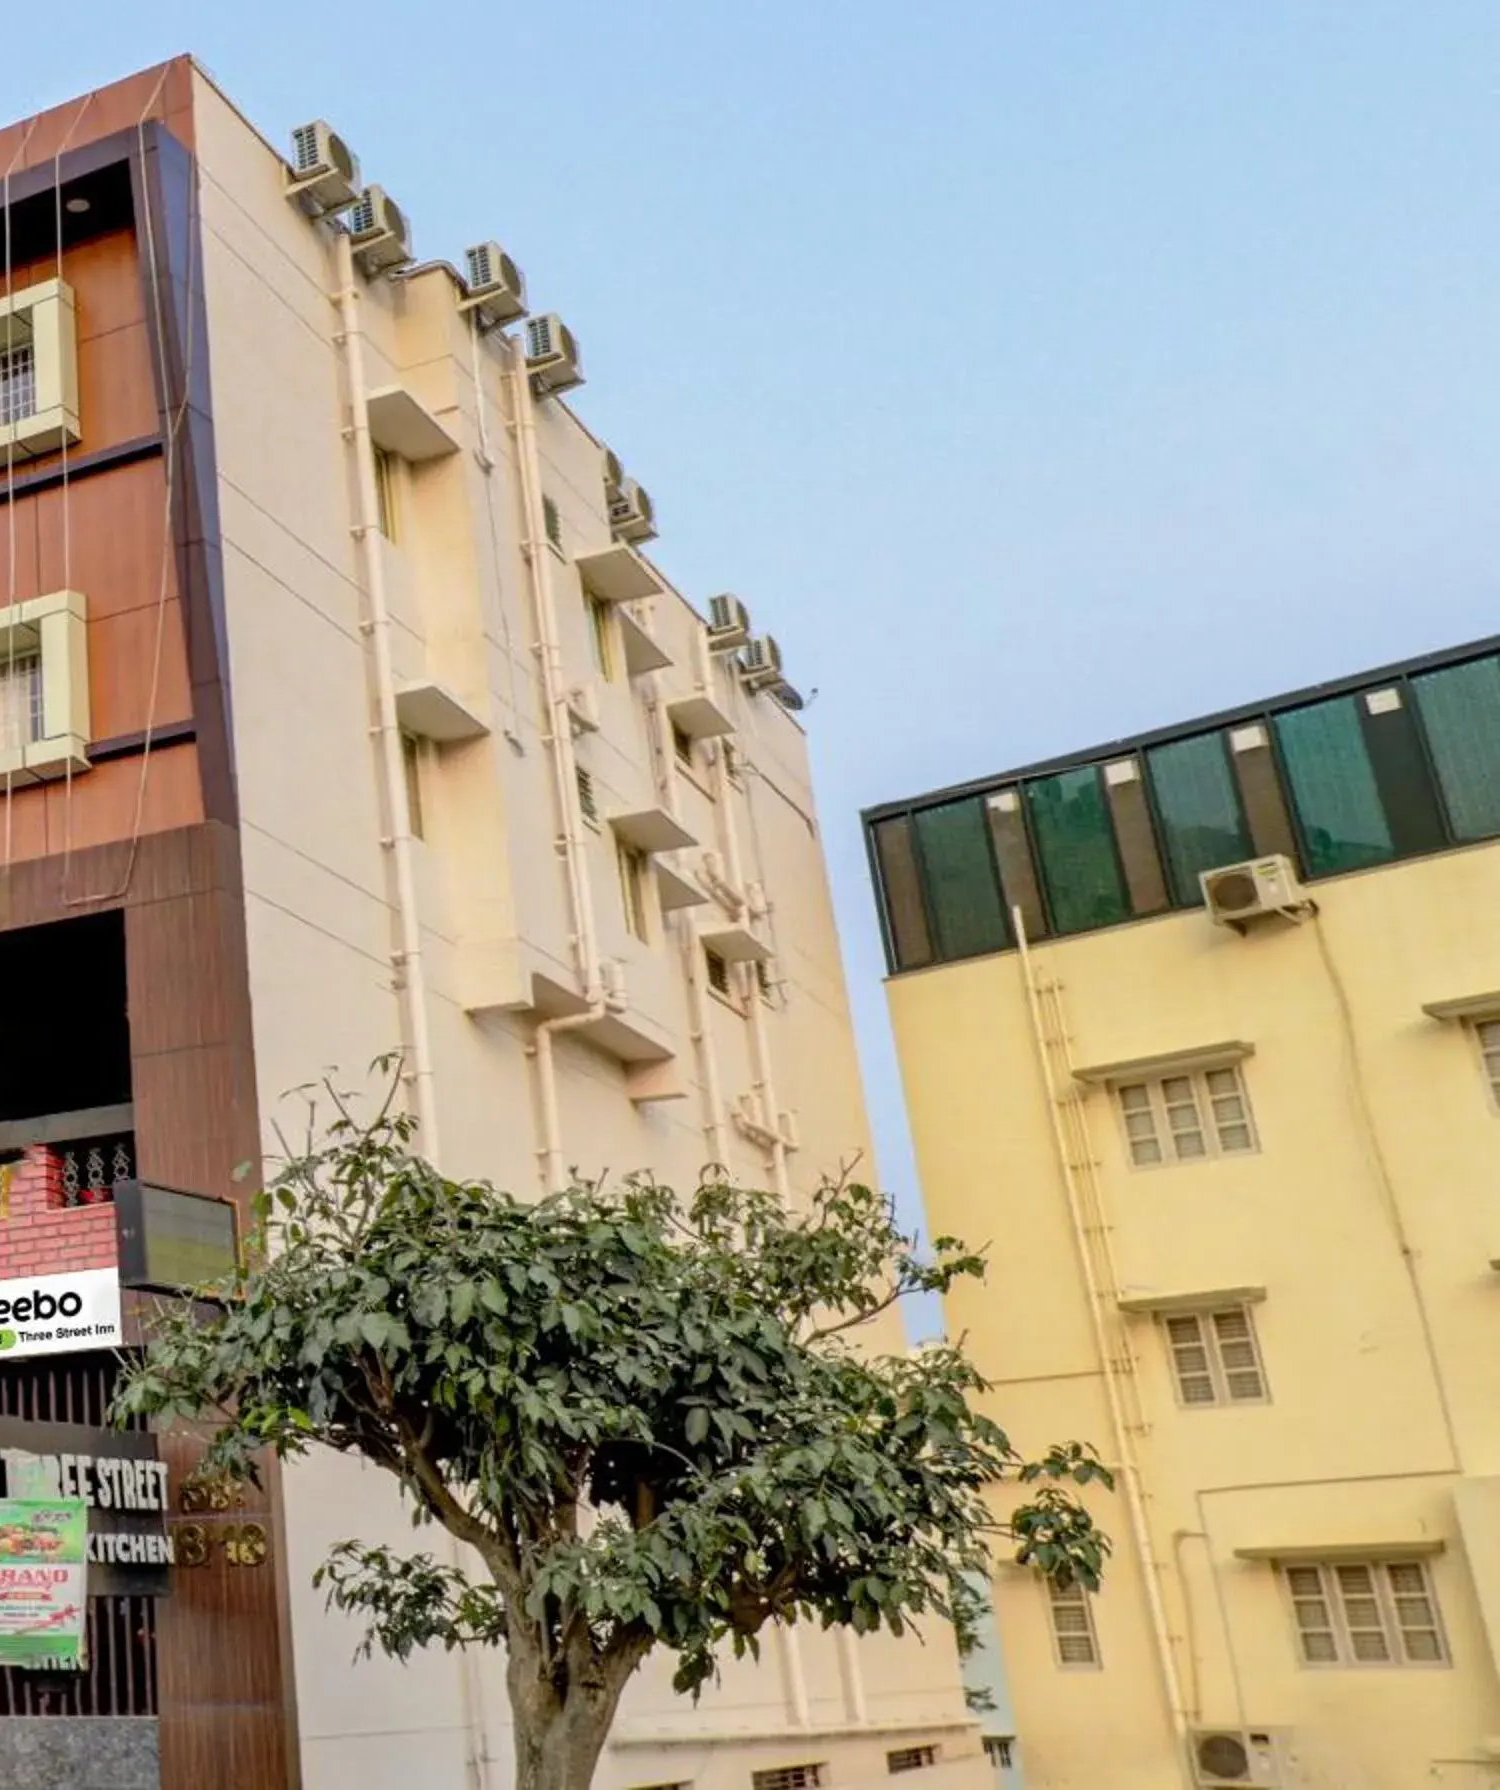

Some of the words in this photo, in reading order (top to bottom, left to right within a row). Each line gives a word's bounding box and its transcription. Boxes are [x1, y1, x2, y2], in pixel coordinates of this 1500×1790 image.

[18, 1330, 53, 1343] Three
[55, 1326, 92, 1340] Street
[95, 1323, 115, 1335] Inn
[97, 1456, 170, 1511] STREET
[85, 1532, 176, 1565] KITCHEN
